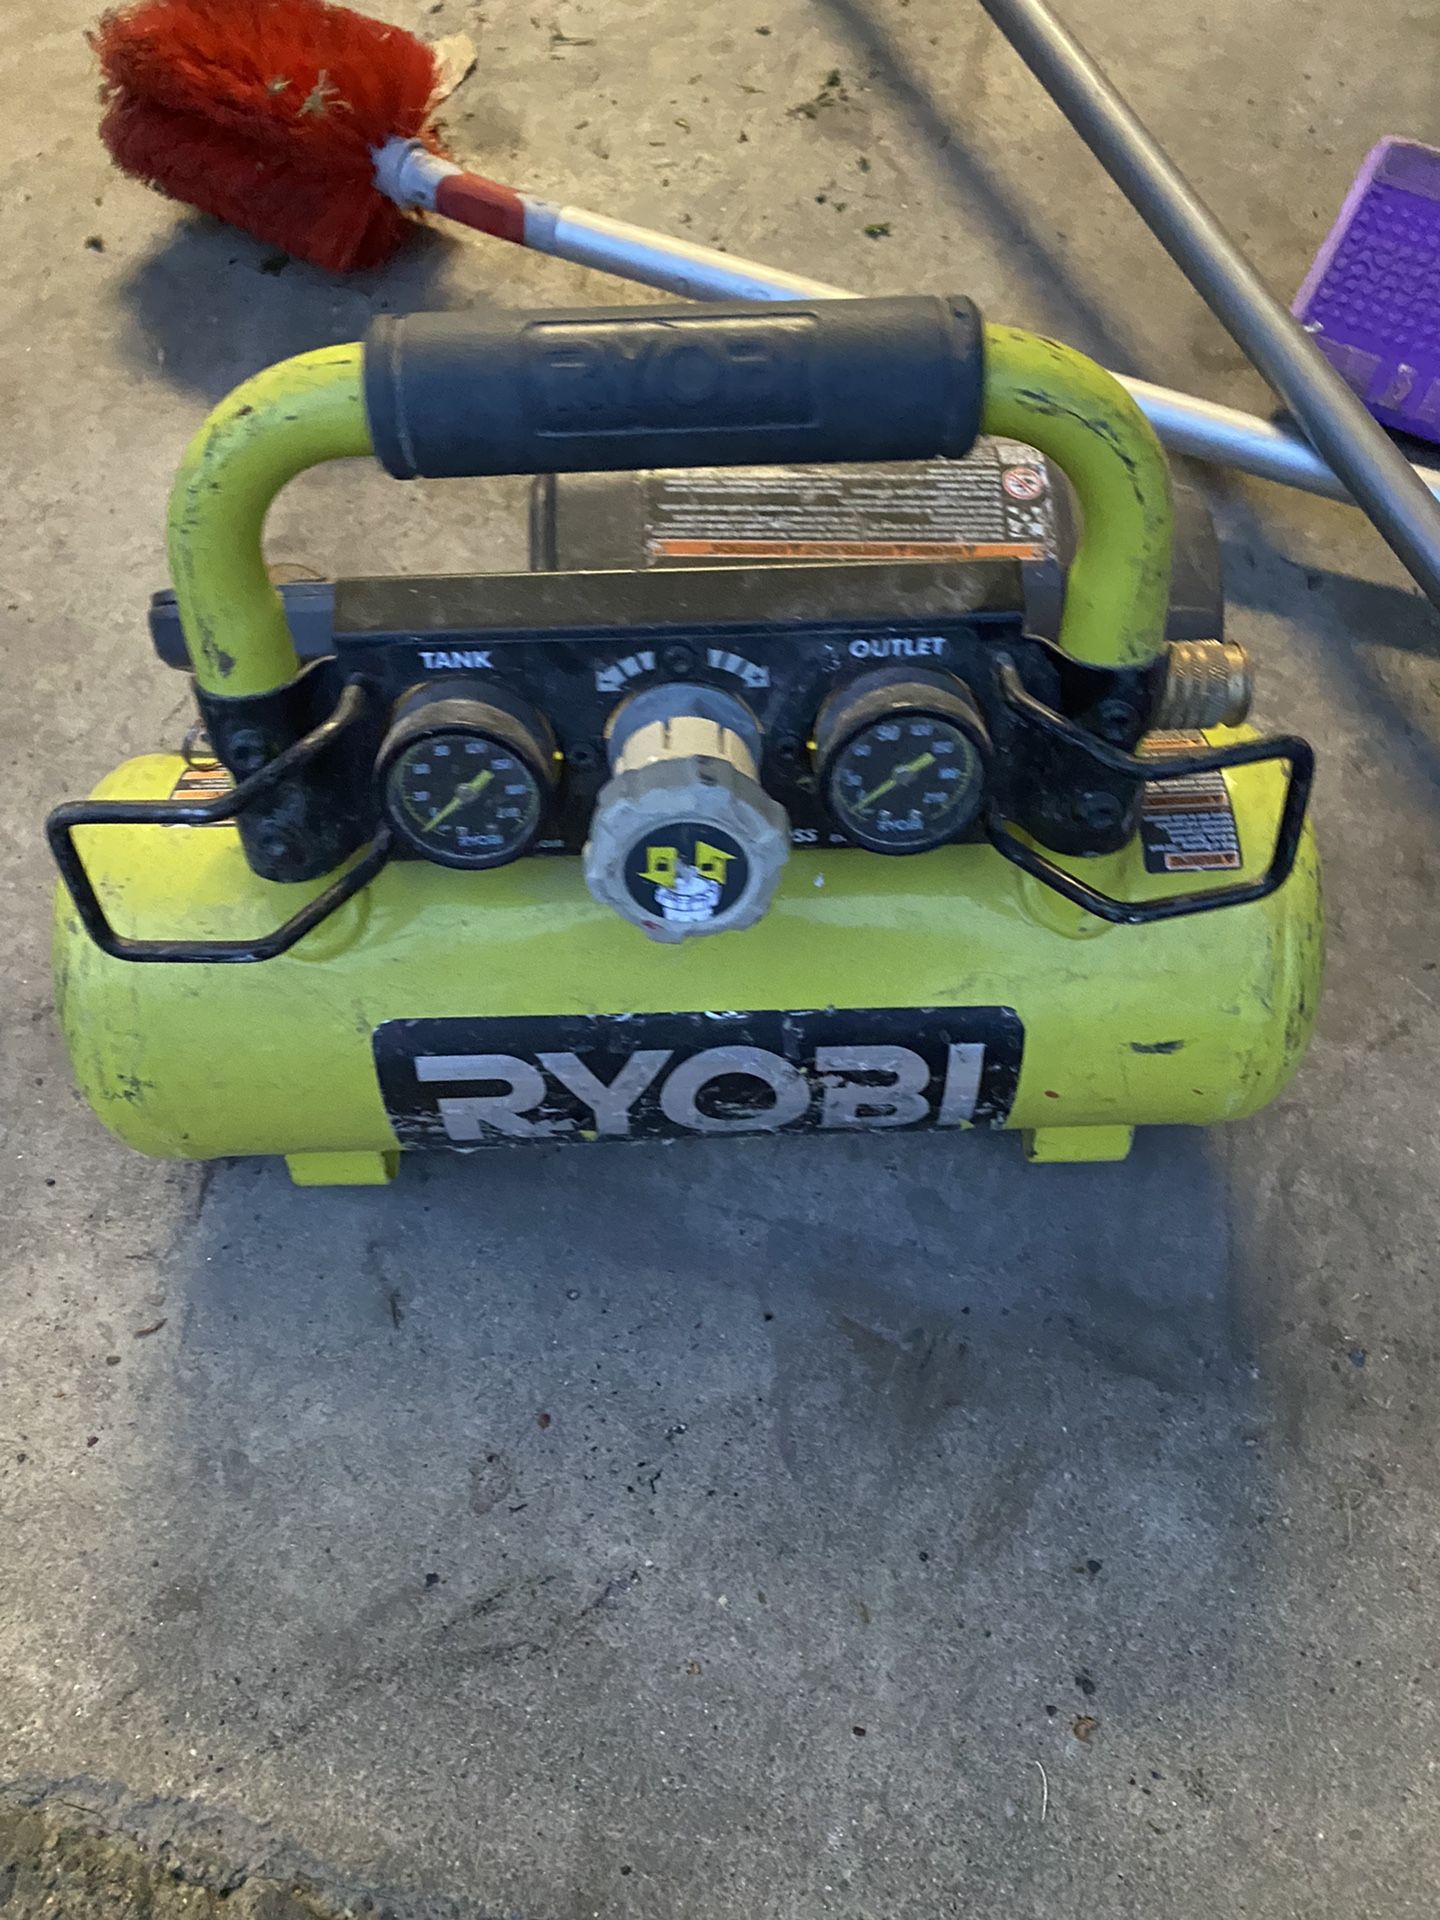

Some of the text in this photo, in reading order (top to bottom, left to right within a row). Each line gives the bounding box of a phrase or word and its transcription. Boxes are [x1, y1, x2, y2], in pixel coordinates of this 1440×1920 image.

[848, 636, 946, 659] OUTLET
[418, 651, 494, 669] TANK
[414, 1042, 986, 1141] RYOBI
